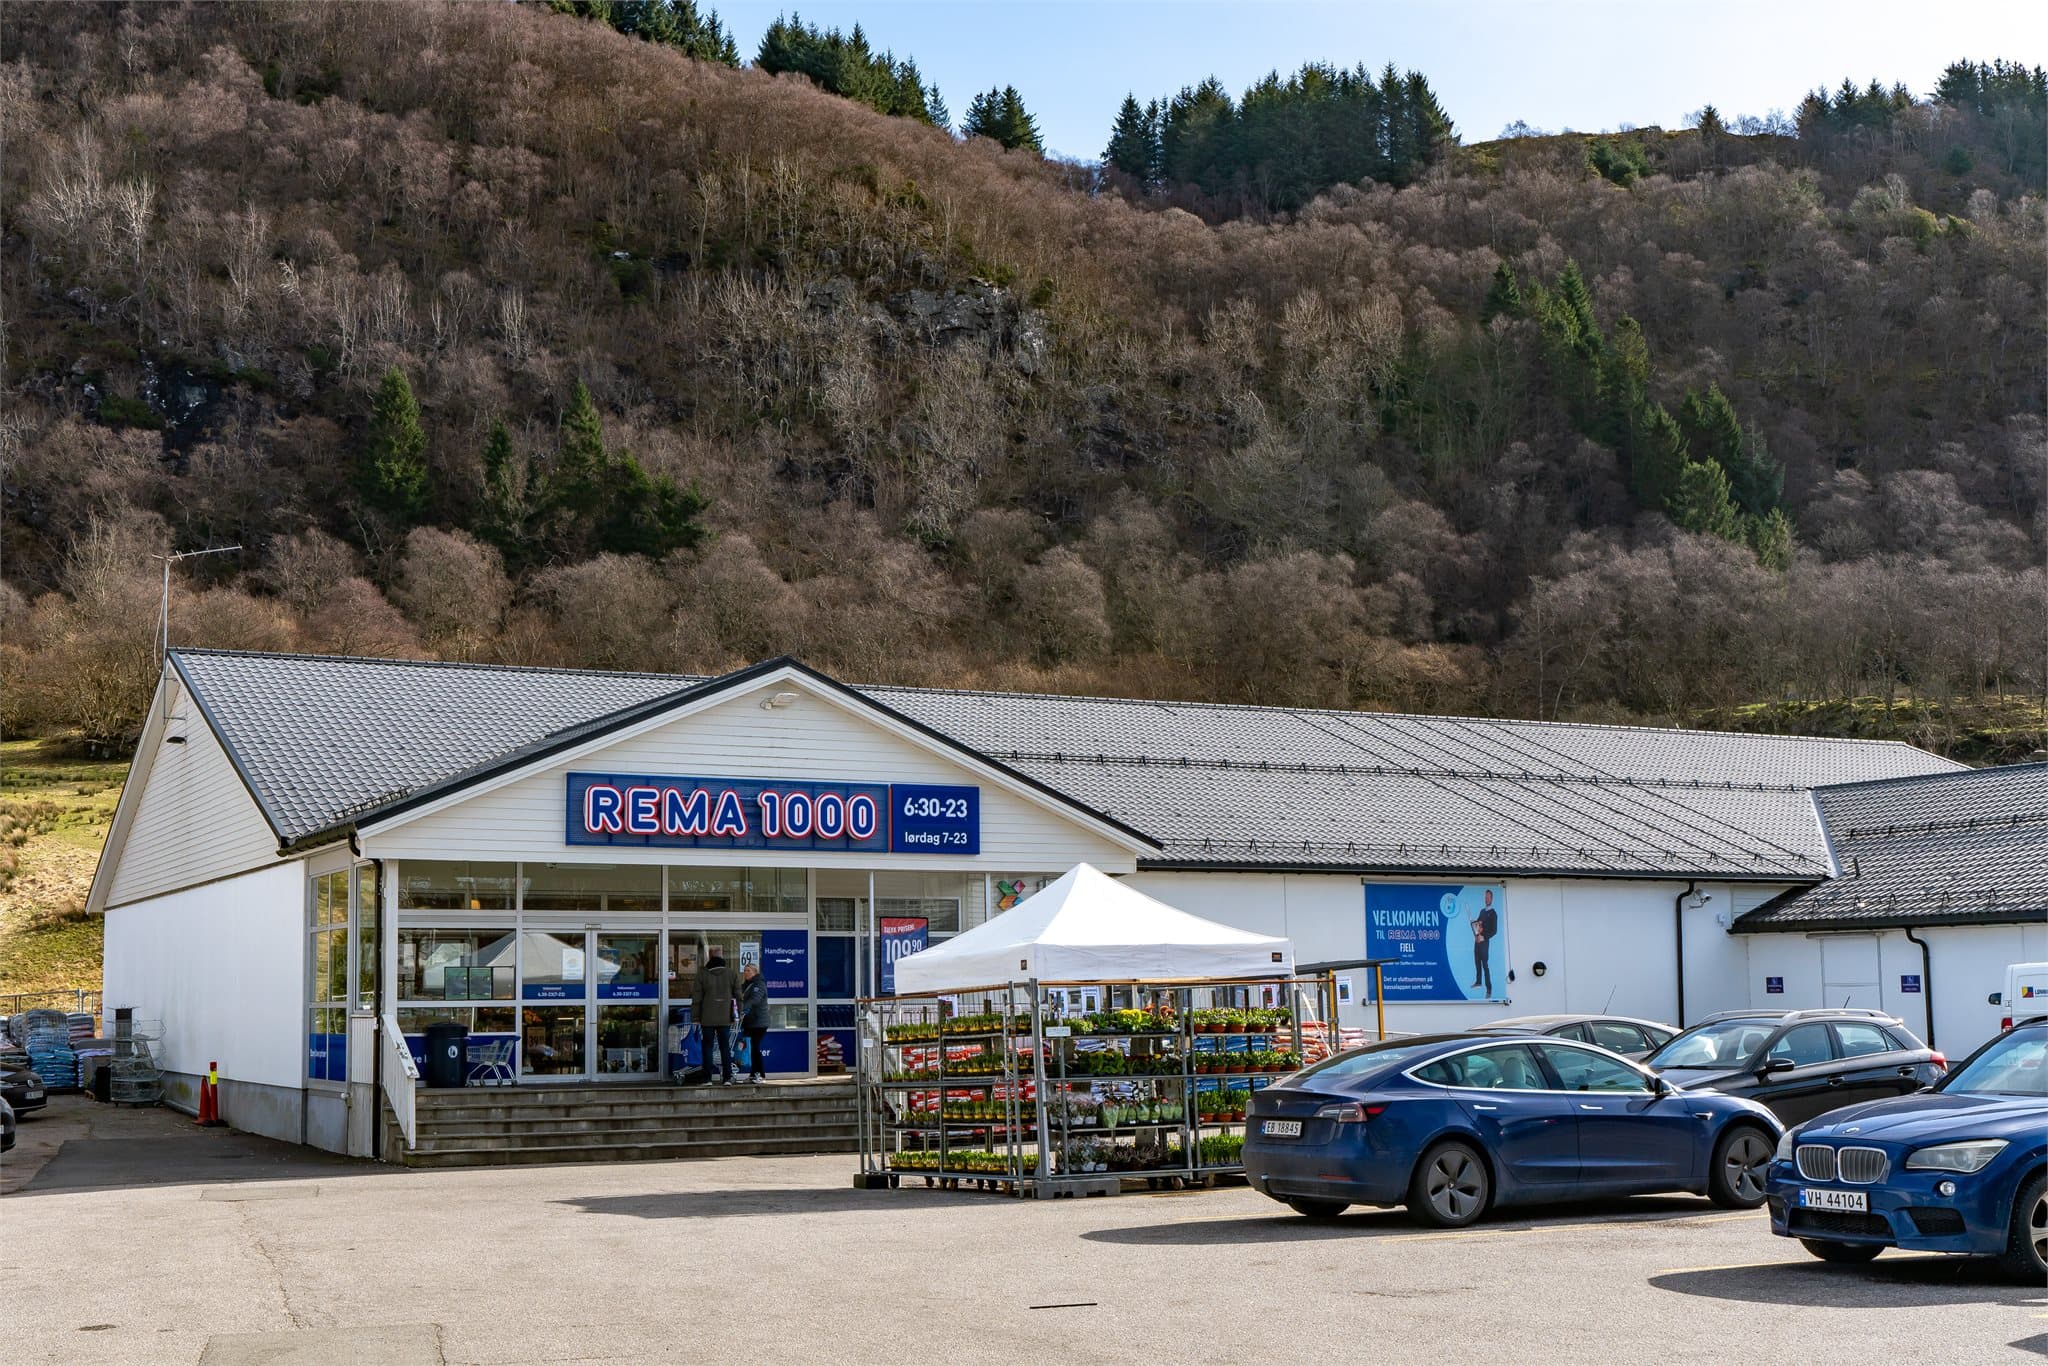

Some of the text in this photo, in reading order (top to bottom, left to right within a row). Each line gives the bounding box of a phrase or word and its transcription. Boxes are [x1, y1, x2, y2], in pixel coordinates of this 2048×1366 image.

[584, 784, 878, 841] REMA 1000
[904, 797, 968, 818] 6:30-23
[904, 831, 968, 846] lørdag 7-23
[1372, 910, 1439, 926] VELKOMMEN
[1376, 929, 1440, 940] TIL REMA 1000
[764, 947, 805, 955] Handlevogner
[1400, 942, 1415, 952] FJELL
[1267, 1121, 1275, 1132] EB
[1807, 1191, 1863, 1208] VH 44104
